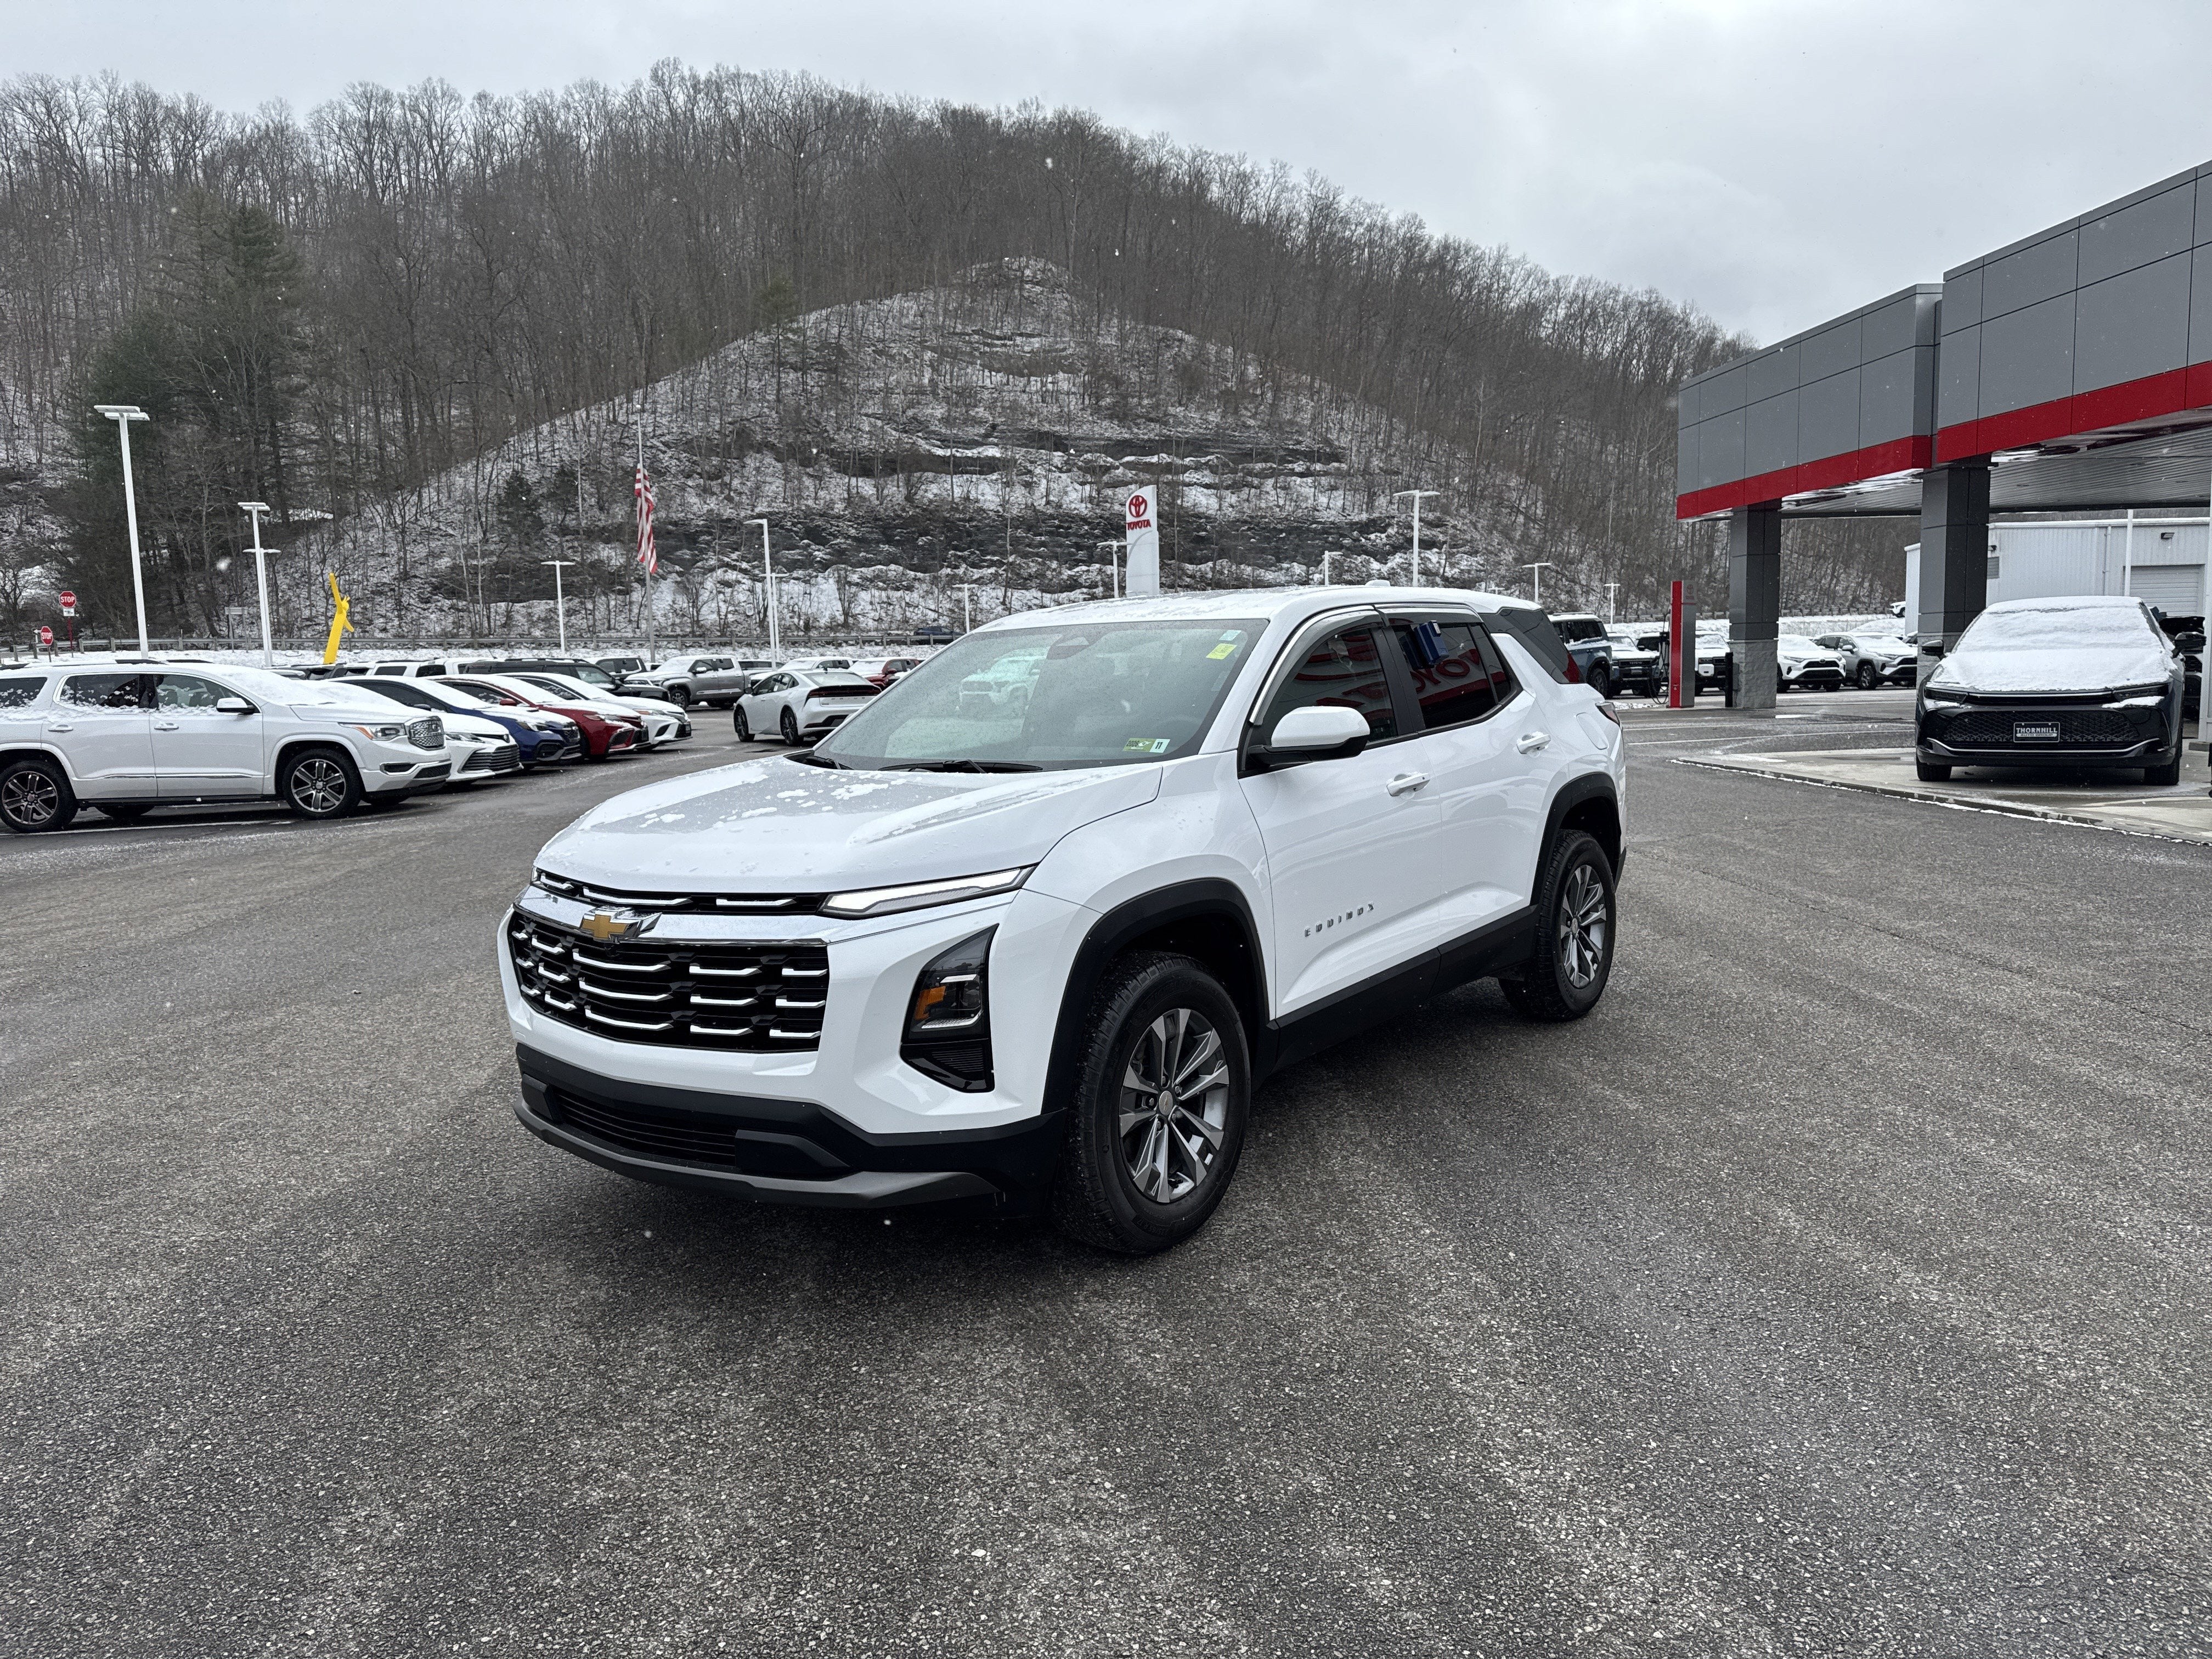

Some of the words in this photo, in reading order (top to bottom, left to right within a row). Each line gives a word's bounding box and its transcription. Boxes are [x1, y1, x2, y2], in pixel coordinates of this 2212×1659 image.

[1125, 519, 1152, 531] TOYOTA
[1155, 741, 1164, 749] 11
[1305, 902, 1374, 937] EQUINOX
